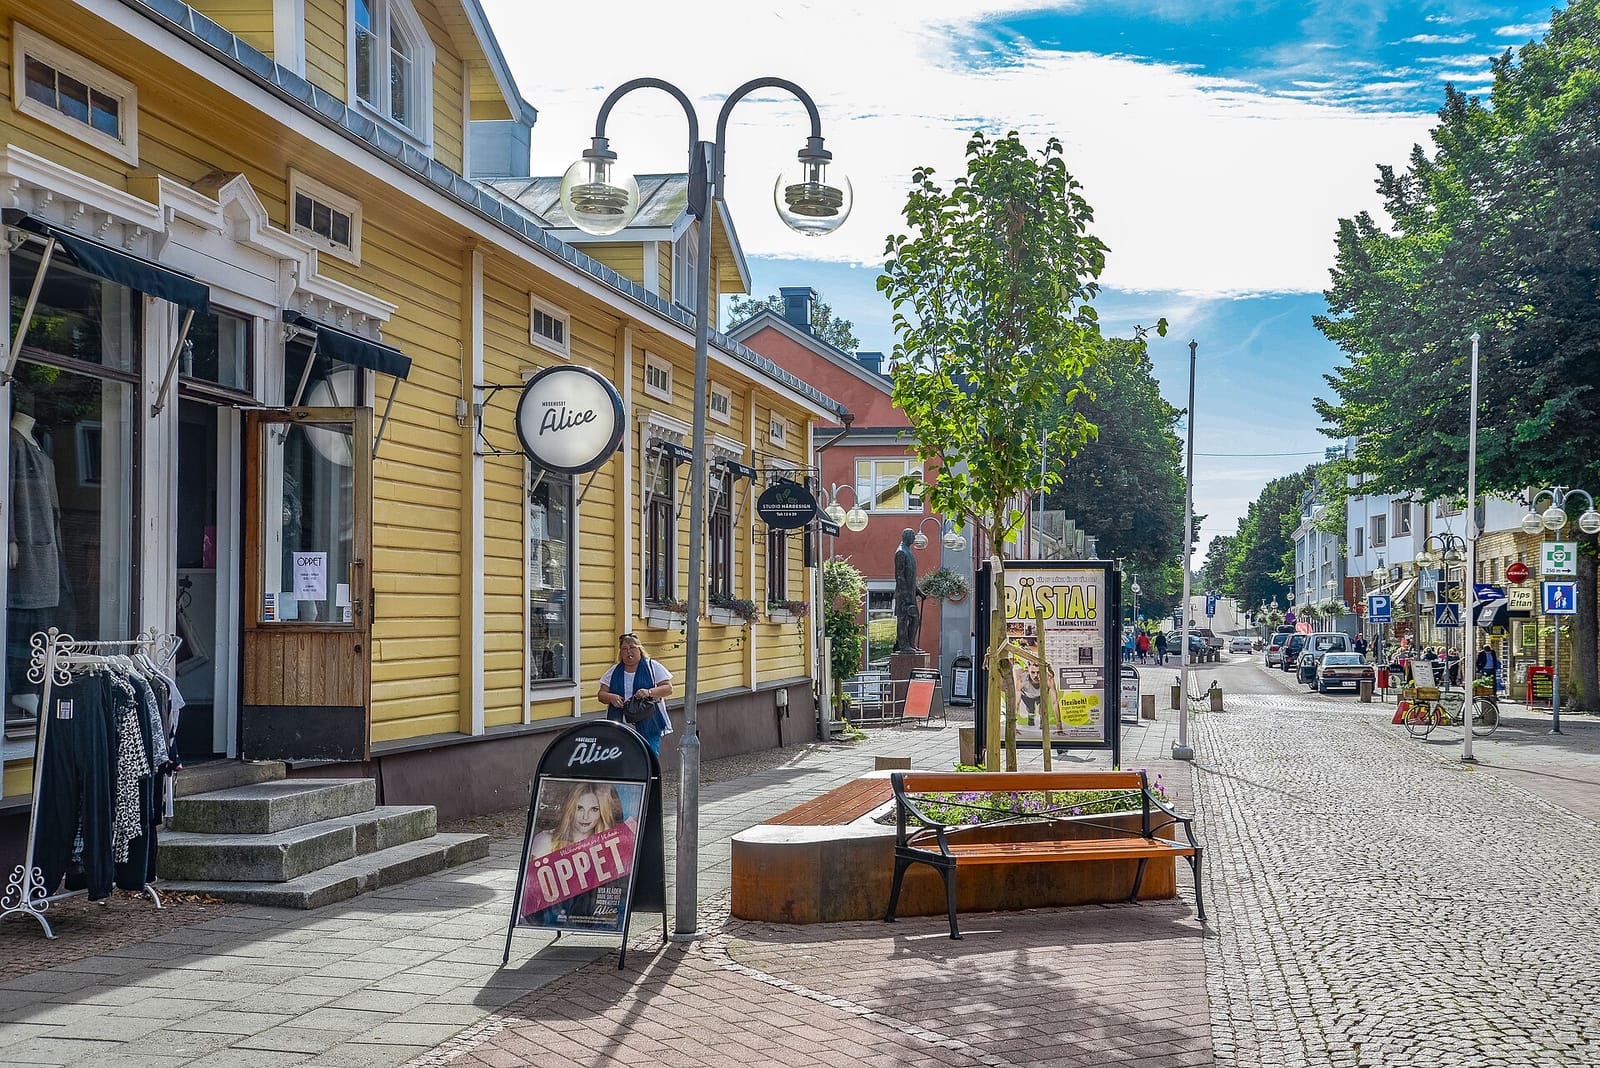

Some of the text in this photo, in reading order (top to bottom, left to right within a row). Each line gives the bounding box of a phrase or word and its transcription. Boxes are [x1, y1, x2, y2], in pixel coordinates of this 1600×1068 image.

[539, 407, 597, 436] Alice
[1003, 577, 1098, 620] BÄSTA!
[1372, 596, 1387, 615] P
[1510, 599, 1532, 607] Ettan
[1512, 590, 1530, 599] Tips
[567, 742, 623, 767] Alice
[534, 837, 626, 903] ÖPPET
[593, 905, 618, 916] Alice
